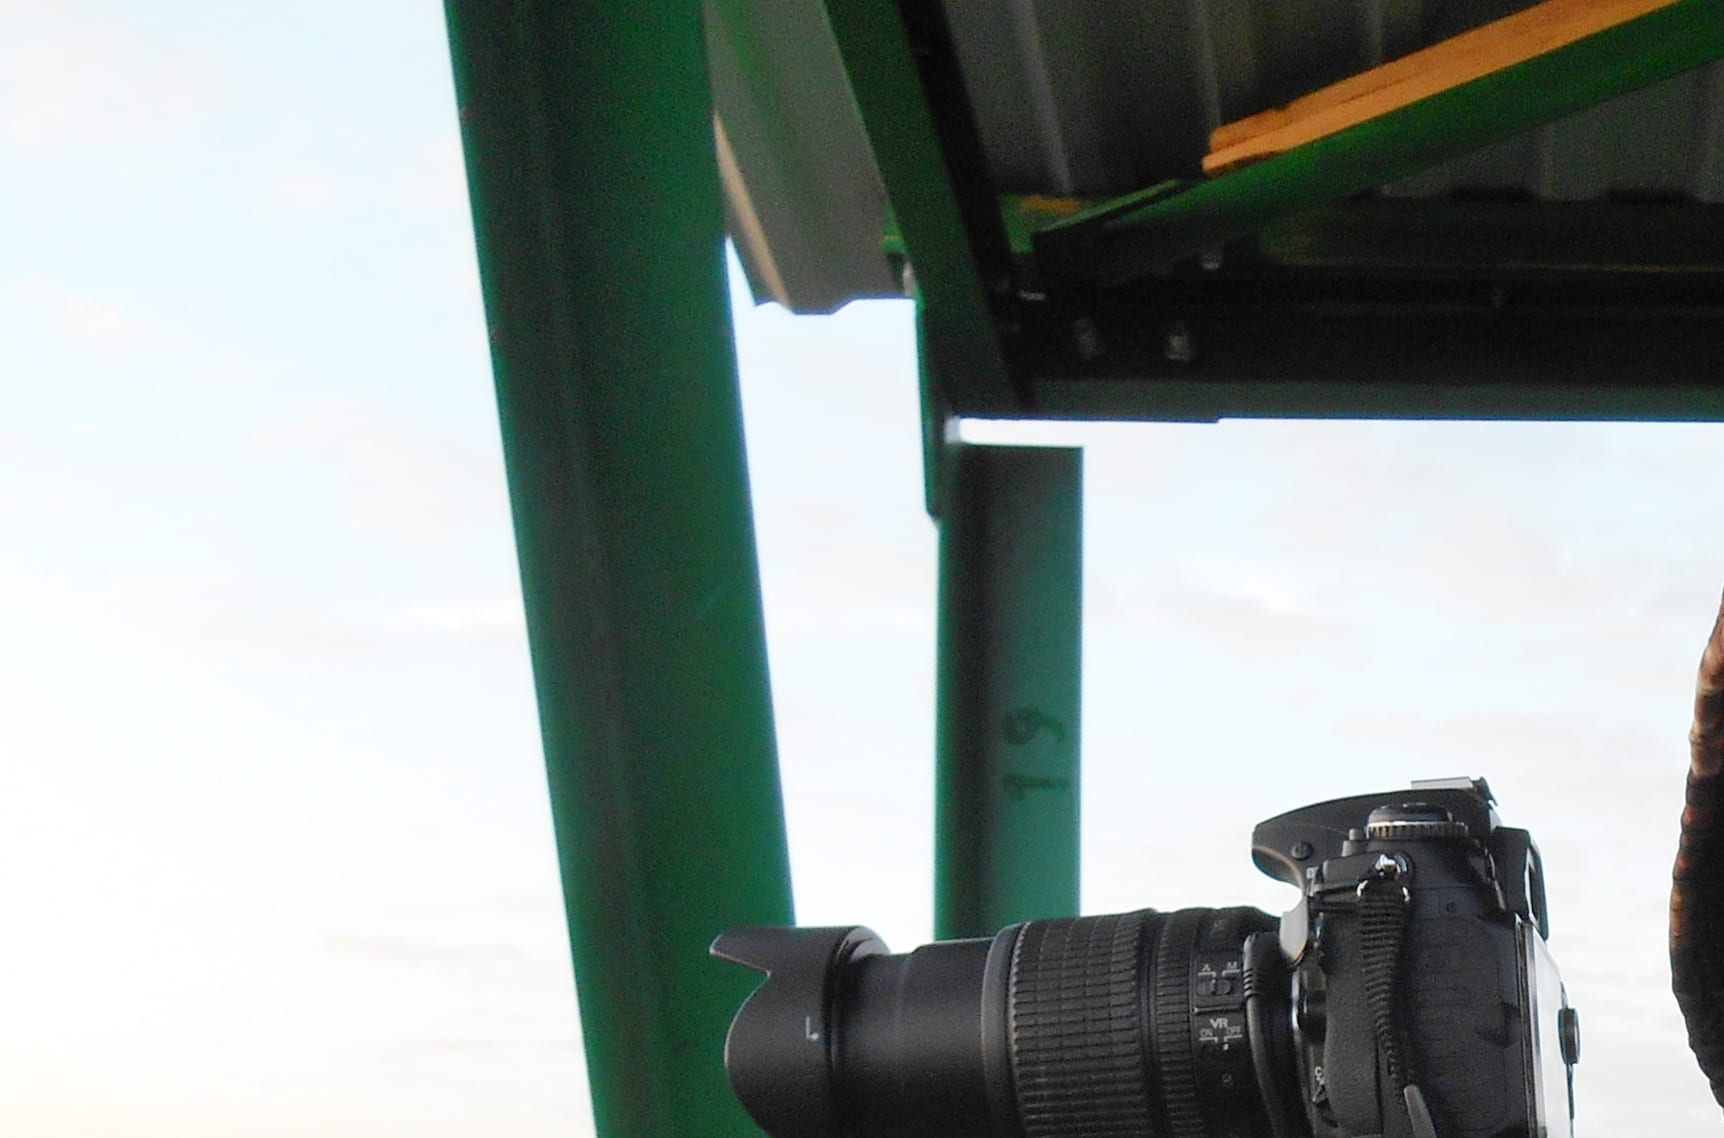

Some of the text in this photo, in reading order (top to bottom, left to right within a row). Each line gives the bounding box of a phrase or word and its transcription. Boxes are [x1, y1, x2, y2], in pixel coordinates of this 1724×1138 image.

[1226, 961, 1238, 970] M
[1209, 1017, 1228, 1029] VR
[1200, 1026, 1241, 1037] ON OFF
